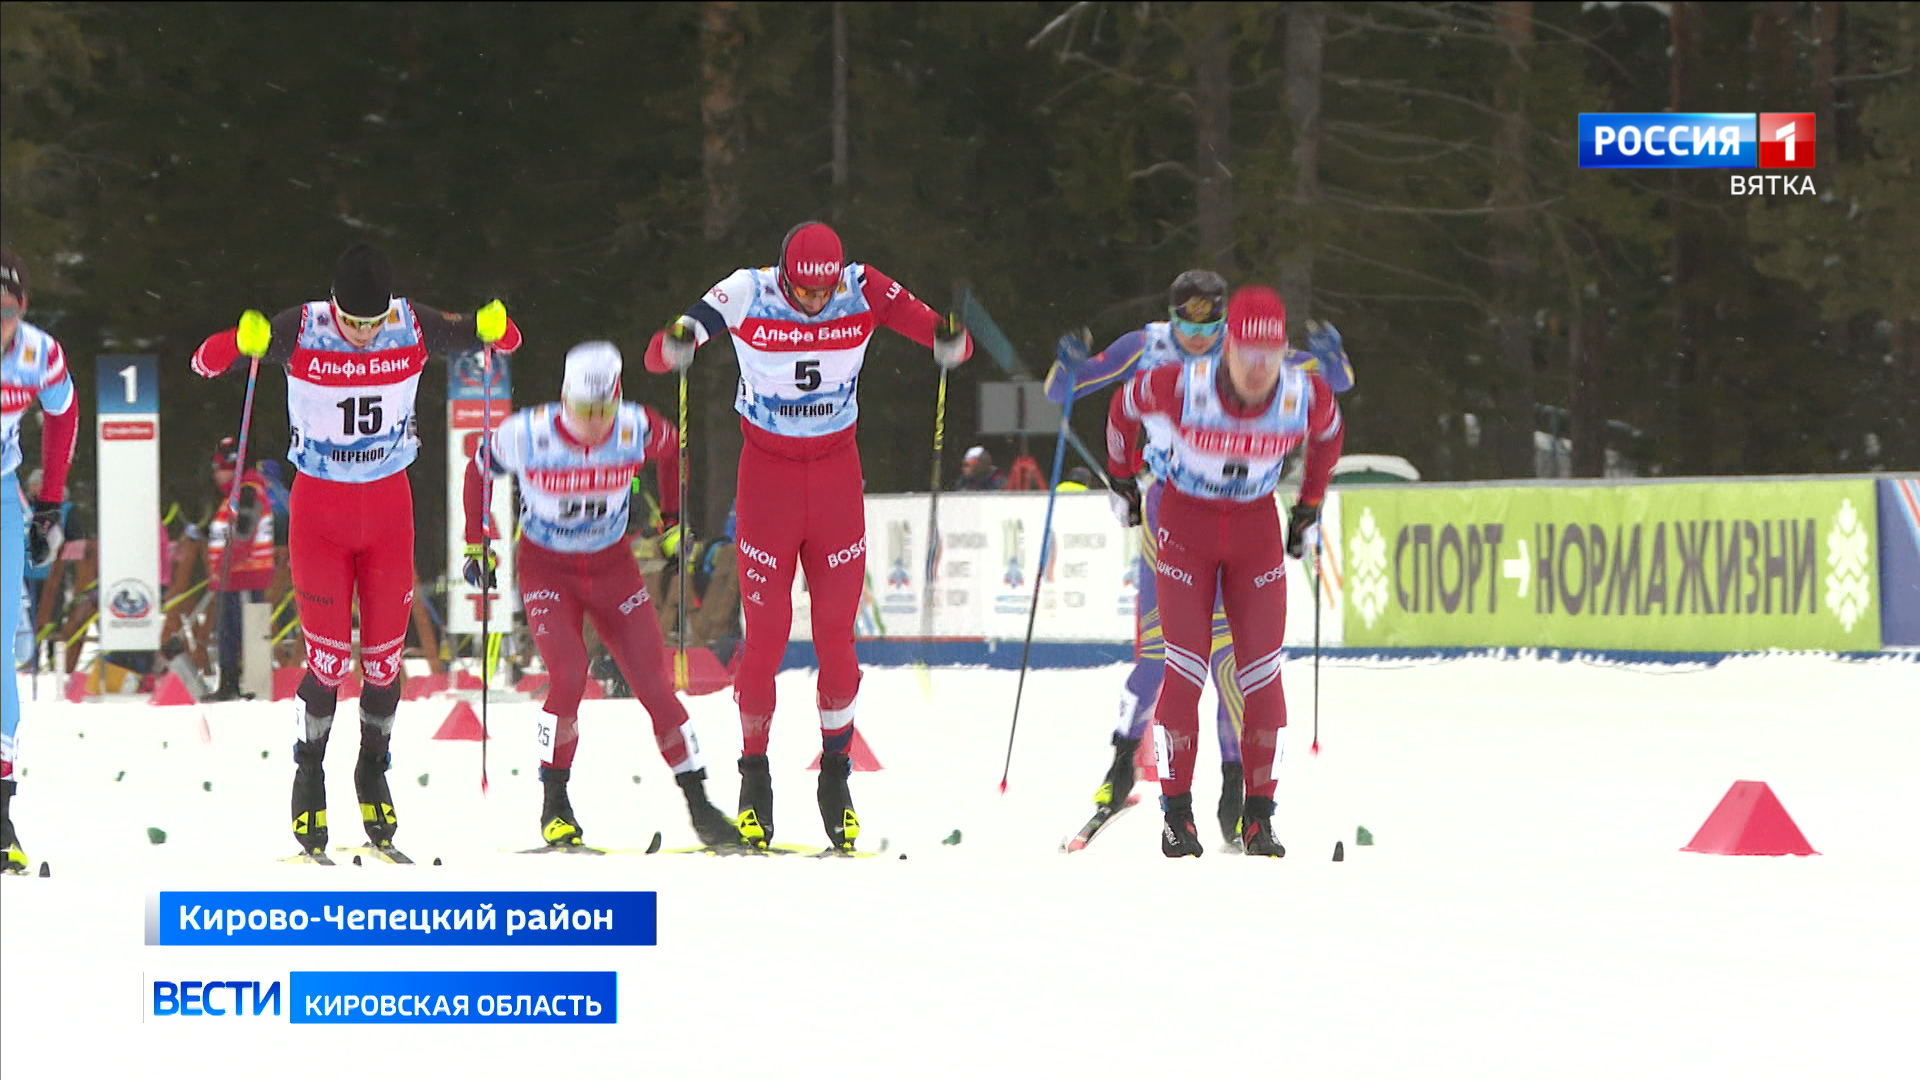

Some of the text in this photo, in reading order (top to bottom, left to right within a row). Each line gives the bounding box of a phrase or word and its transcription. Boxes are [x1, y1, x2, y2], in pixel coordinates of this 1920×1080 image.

[752, 323, 863, 346] Альфа Банк
[118, 365, 138, 403] 1
[307, 356, 410, 379] Альфа Банк
[795, 359, 822, 391] 5
[336, 395, 383, 435] 15
[827, 535, 867, 568] BOSC
[1394, 518, 1816, 616] СПОРТ НОРМА ЖИЗНИ
